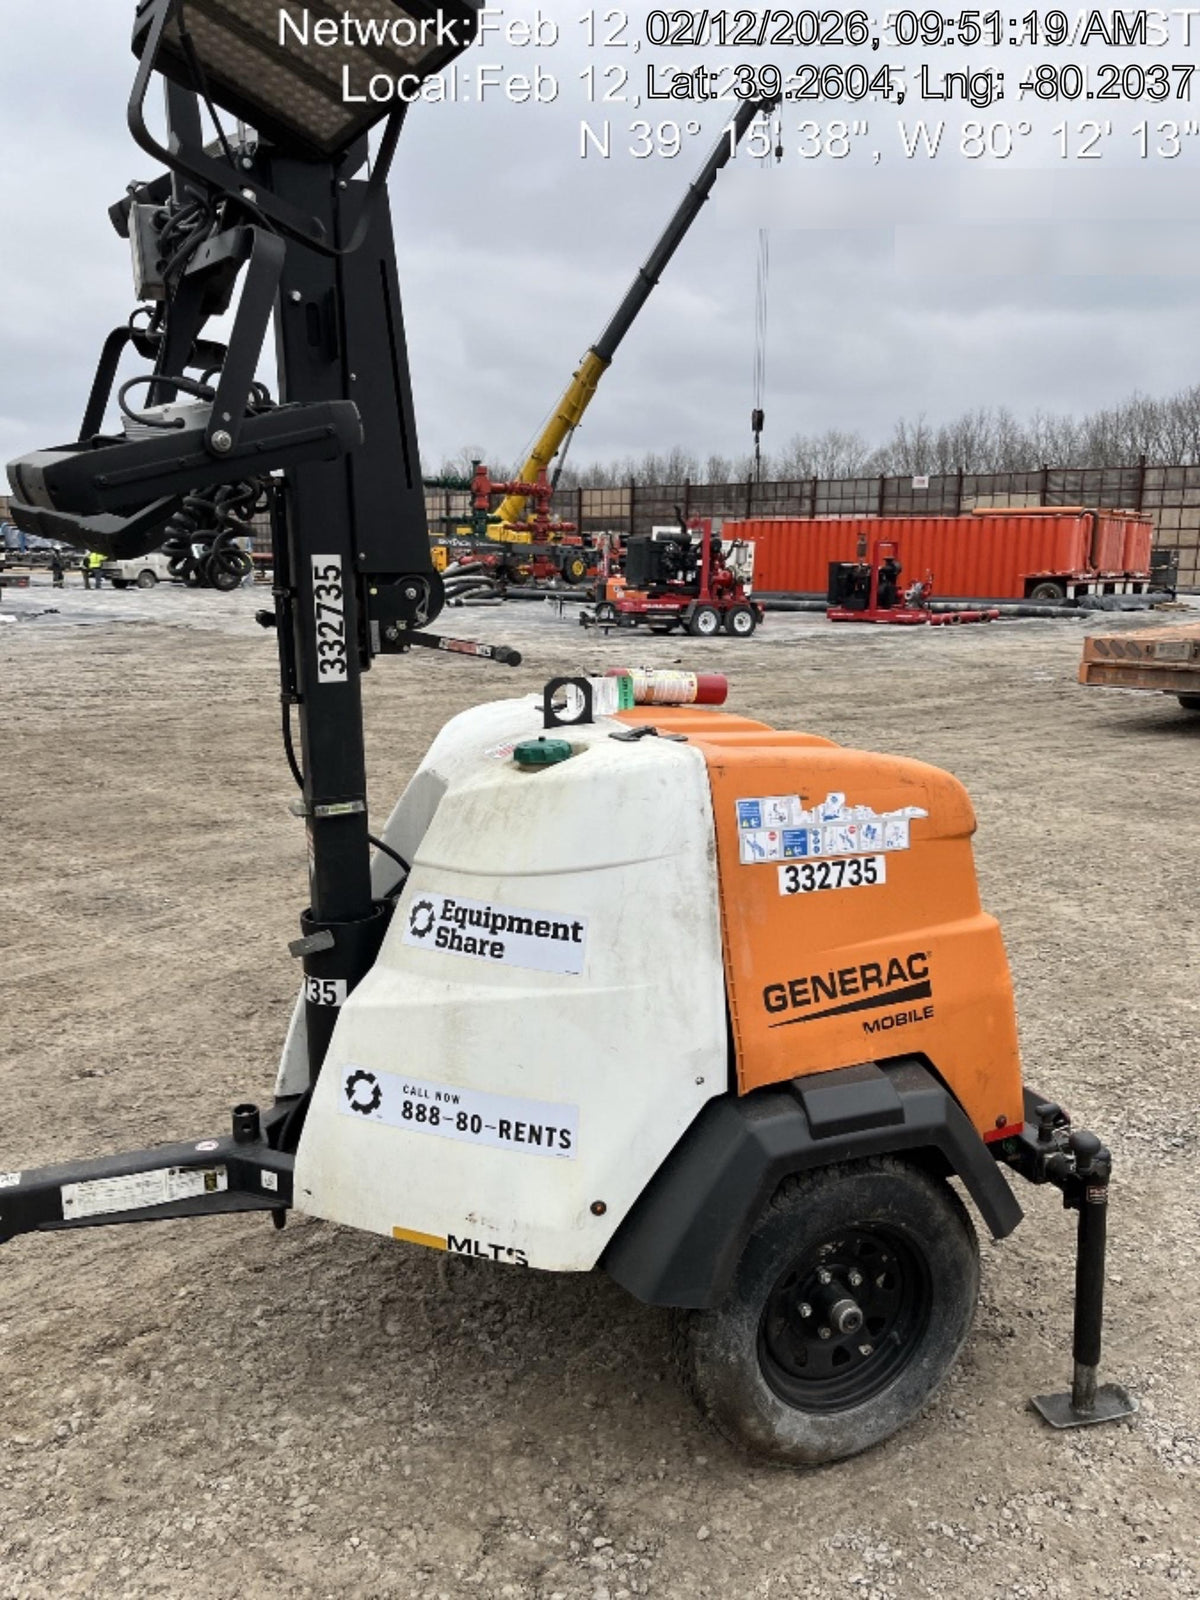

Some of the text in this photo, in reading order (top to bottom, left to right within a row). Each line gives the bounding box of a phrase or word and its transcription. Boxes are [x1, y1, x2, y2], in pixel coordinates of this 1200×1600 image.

[314, 564, 346, 675] 332735
[785, 857, 878, 895] 332735
[434, 925, 505, 959] Share
[440, 898, 584, 944] Equipment
[762, 952, 930, 1014] GENERAC
[862, 1005, 935, 1035] MOBILE
[402, 1083, 461, 1105] CALL NOW
[401, 1099, 573, 1150] 888-80-RENTS
